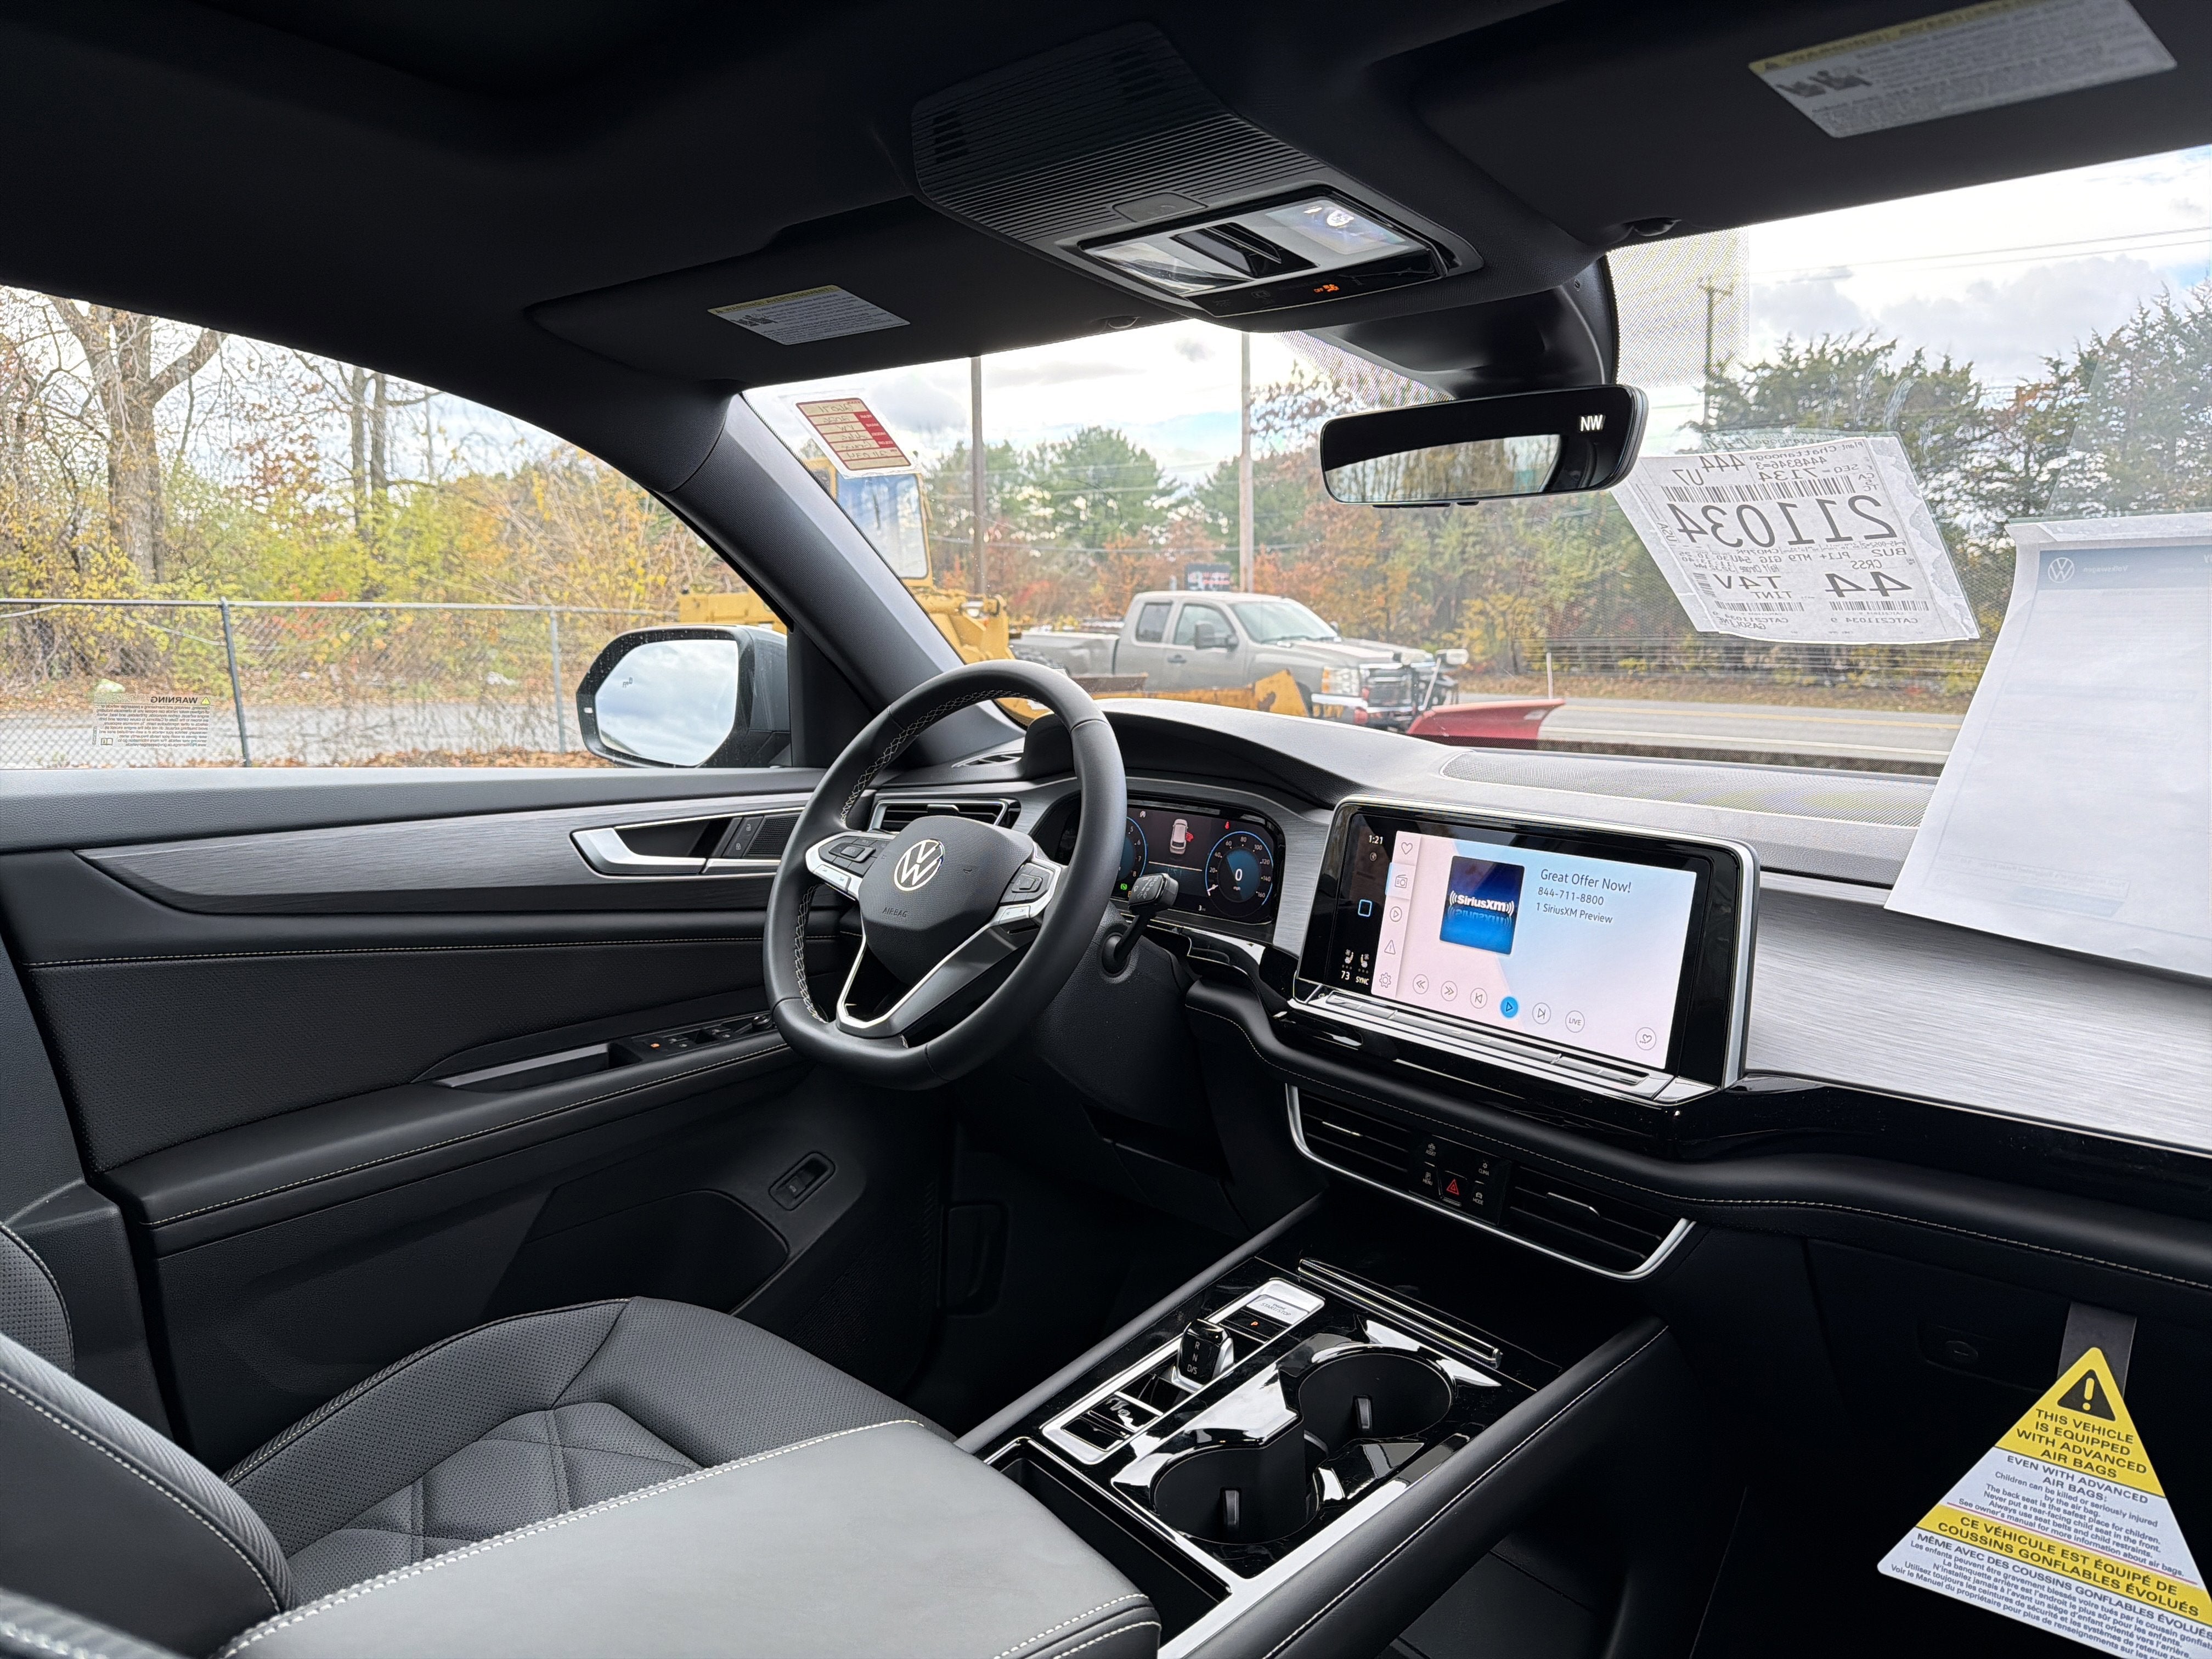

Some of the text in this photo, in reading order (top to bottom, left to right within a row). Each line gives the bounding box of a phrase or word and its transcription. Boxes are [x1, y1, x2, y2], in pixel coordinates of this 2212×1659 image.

[1580, 415, 1604, 432] NW
[1368, 836, 1383, 845] 1:21
[1235, 869, 1242, 881] 0
[1541, 868, 1631, 893] Great Offer Now!
[1537, 887, 1604, 905] 844-711-8800
[882, 907, 908, 918] AIRBAG
[1543, 902, 1577, 917] SiriusXM
[1579, 909, 1613, 923] Preview
[1341, 970, 1350, 980] 73
[1356, 976, 1369, 985] SYNC
[1568, 1017, 1581, 1026] LIVE
[1261, 1302, 1291, 1316] START/STOP
[1192, 1353, 1198, 1362] N
[1195, 1341, 1200, 1350] R
[1187, 1364, 1198, 1374] D/S
[2035, 1408, 2133, 1444] THIS VEHICLE
[2035, 1420, 2130, 1455] IS EQUIPPED
[2016, 1427, 2147, 1474] WITH ADVANCED
[2040, 1449, 2117, 1478] AIR BAGS
[2007, 1454, 2148, 1504] EVEN WITH ADVANCED
[2042, 1476, 2107, 1502] AIR BAGS:
[1995, 1471, 2158, 1527] Children can be killed or seriously injured
[2044, 1493, 2101, 1519] by the air bag.
[1983, 1490, 2007, 1503] Never
[2007, 1499, 2021, 1508] put
[2029, 1506, 2072, 1525] rear-facing
[2073, 1520, 2093, 1532] child
[2094, 1526, 2112, 1539] seat
[2113, 1531, 2121, 1540] in
[2123, 1535, 2137, 1544] the
[2138, 1539, 2161, 1553] front.
[1984, 1483, 2000, 1494] The
[2001, 1488, 2020, 1500] back
[2021, 1496, 2038, 1505] seat
[2047, 1503, 2061, 1515] the
[2062, 1508, 2086, 1523] safest
[2087, 1516, 2109, 1528] place
[2111, 1522, 2124, 1532] for
[2124, 1528, 2160, 1544] children.
[1958, 1498, 2184, 1577] See owner's manual for more information about air bags.
[1988, 1500, 2153, 1558] Always use seat belts and child restraints.
[1960, 1516, 2177, 1595] CE VÉHICULE EST ÉQUIPÉ DE
[1917, 1532, 1952, 1550] MÊME
[1954, 1545, 1984, 1561] AVEC
[1987, 1555, 2009, 1569] DES
[2012, 1564, 2072, 1590] COUSSINS
[2075, 1585, 2154, 1619] GONFLABLES
[1938, 1522, 2198, 1616] COUSSINS GONFLABLES ÉVOLUÉS
